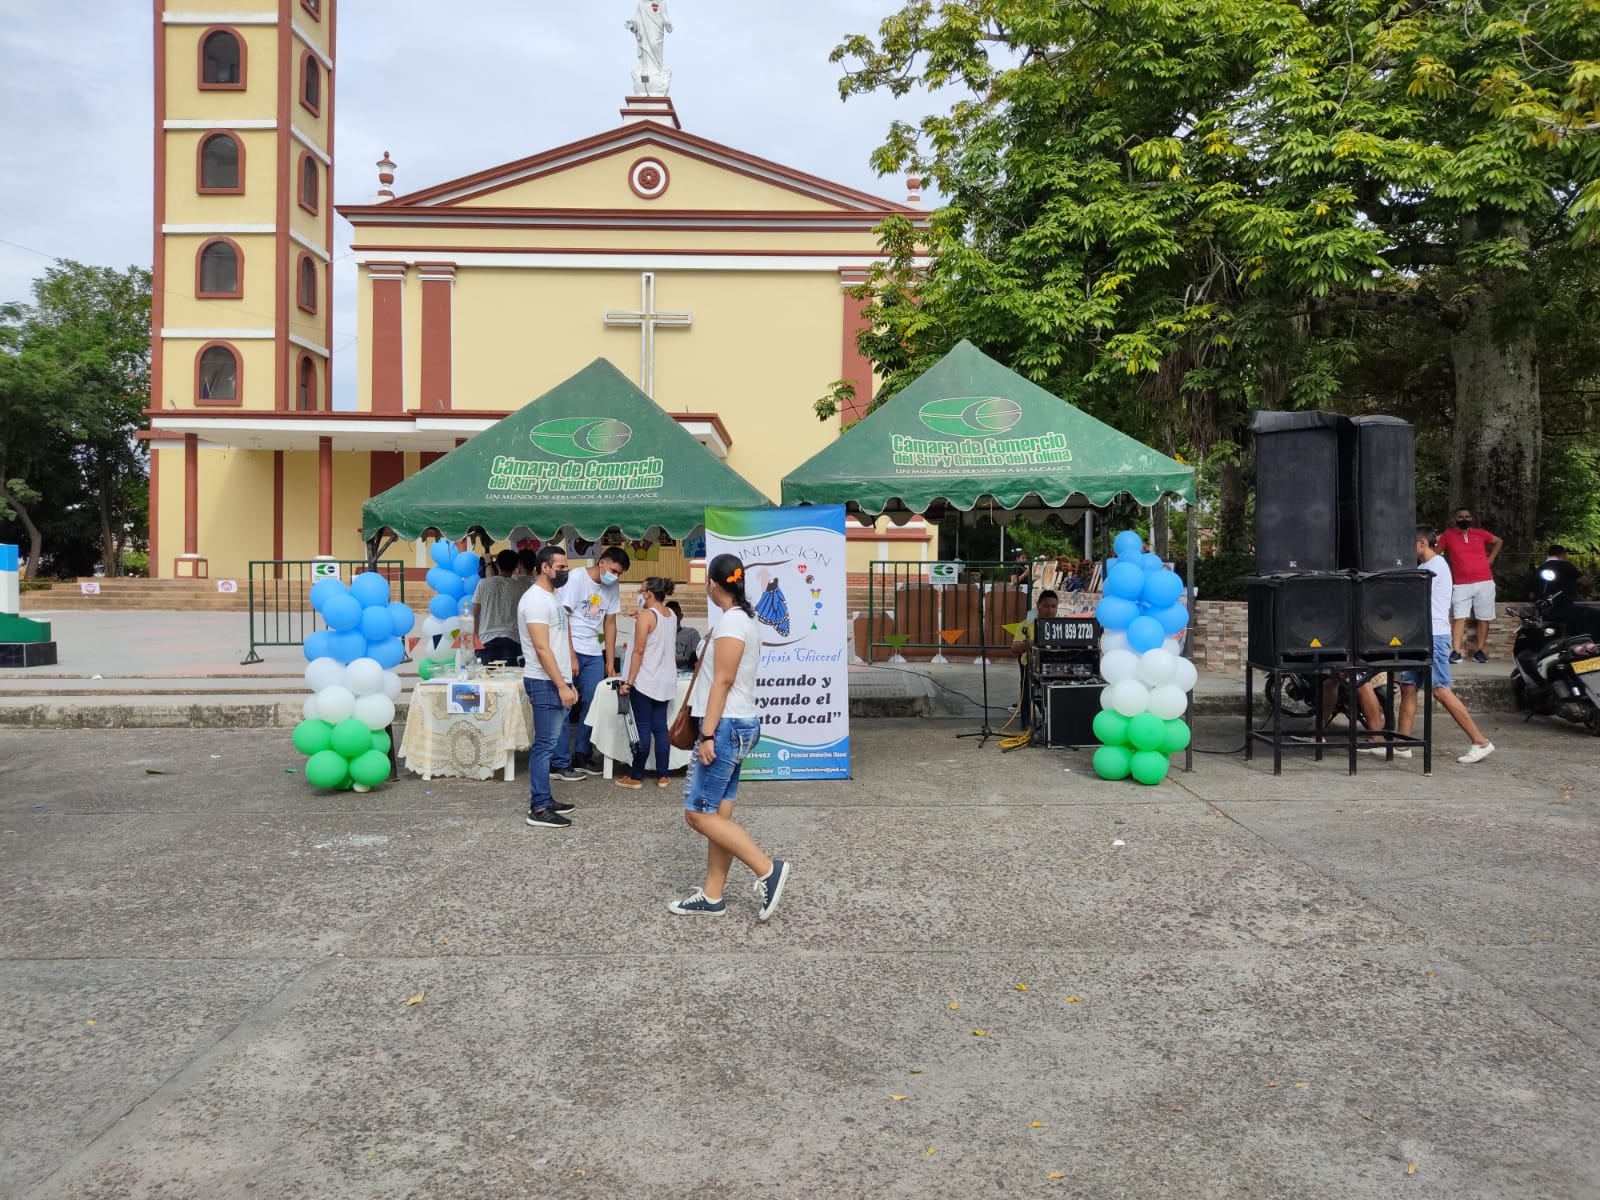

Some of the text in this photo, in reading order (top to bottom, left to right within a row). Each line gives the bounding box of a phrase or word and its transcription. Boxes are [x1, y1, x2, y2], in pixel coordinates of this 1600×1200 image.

[891, 432, 1067, 456] Cámara de Comercio
[893, 449, 1073, 467] del Sur y Oriente del Tolima
[491, 456, 664, 479] Cámara de Comercio
[1028, 465, 1073, 473] ALCANCE
[488, 474, 664, 493] del Sur y Oriente del Tolima
[1051, 623, 1094, 639] 311 859 2720
[761, 649, 791, 669] rfosis
[756, 674, 832, 688] ucando y
[754, 692, 831, 708] yando el
